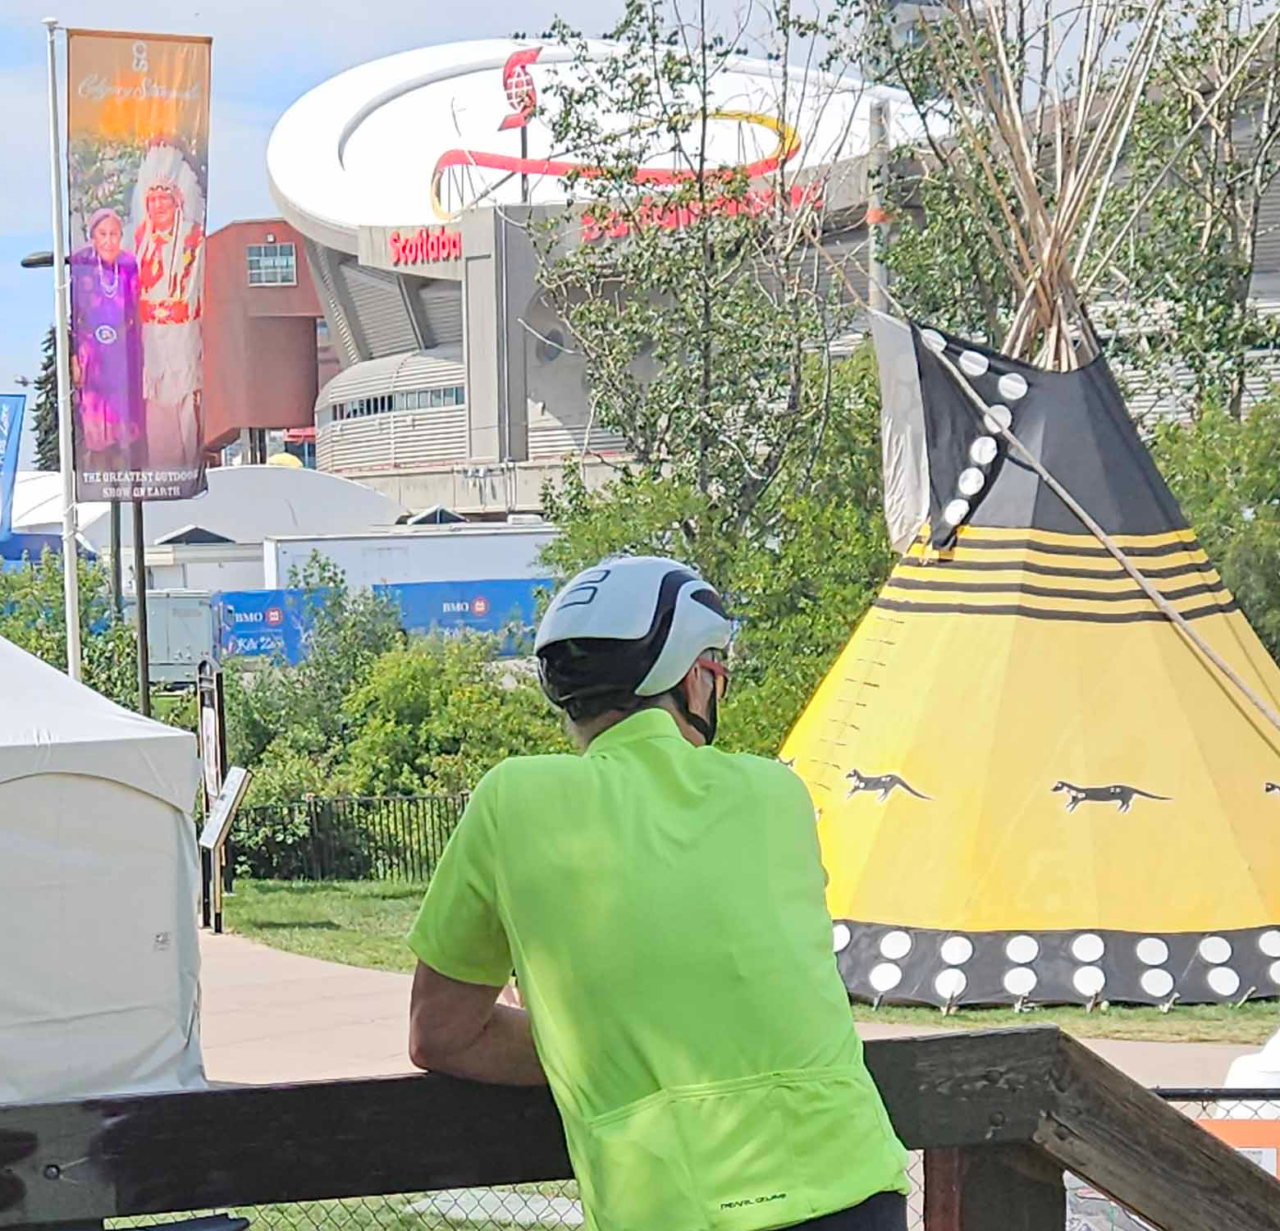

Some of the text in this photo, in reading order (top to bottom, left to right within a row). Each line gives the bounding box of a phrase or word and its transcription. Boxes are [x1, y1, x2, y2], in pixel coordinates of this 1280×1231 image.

[389, 226, 462, 265] Scotiaba
[83, 472, 101, 483] THE
[103, 471, 153, 482] GREATEST
[133, 487, 146, 497] ON
[147, 486, 180, 496] EARTH
[443, 602, 469, 613] BMO
[235, 611, 263, 623] BMO
